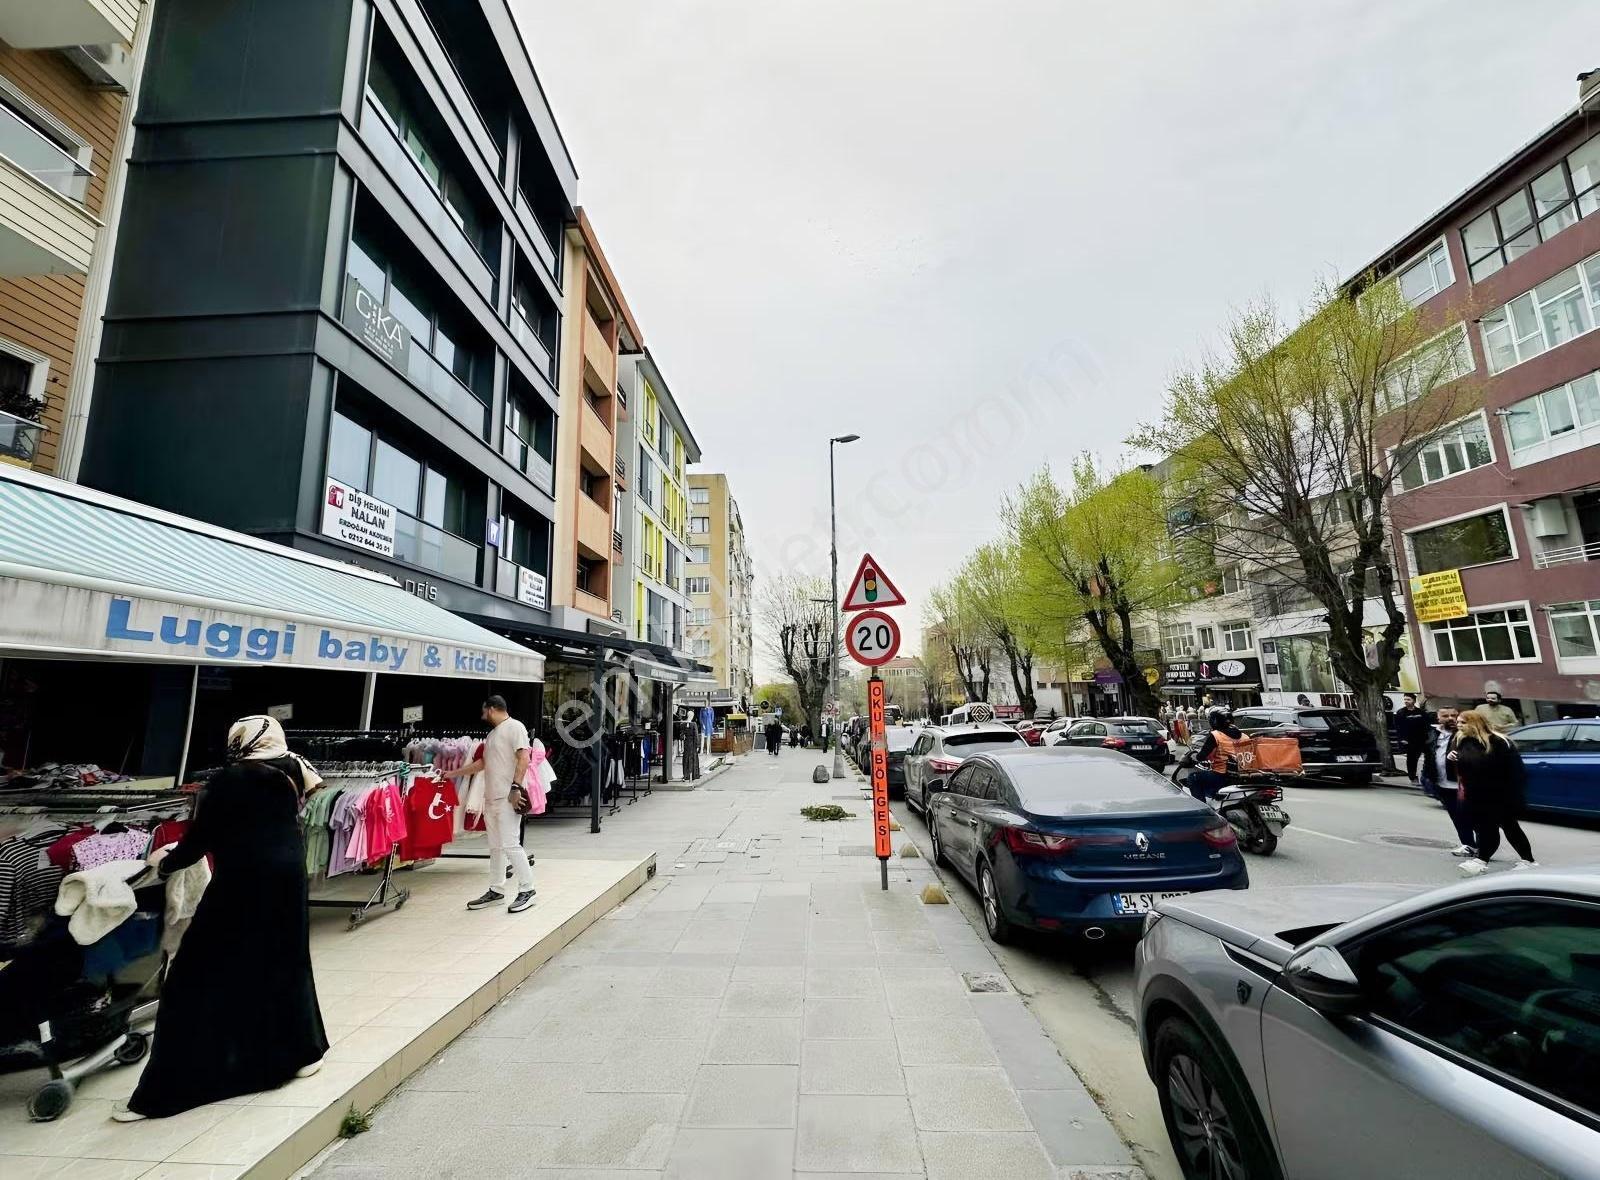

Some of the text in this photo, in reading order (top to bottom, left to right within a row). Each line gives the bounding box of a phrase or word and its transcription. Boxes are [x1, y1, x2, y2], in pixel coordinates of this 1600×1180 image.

[351, 506, 386, 530] NALAN
[106, 599, 497, 673] Luggi baby & kids
[857, 624, 891, 651] 20
[1121, 894, 1137, 909] 34
